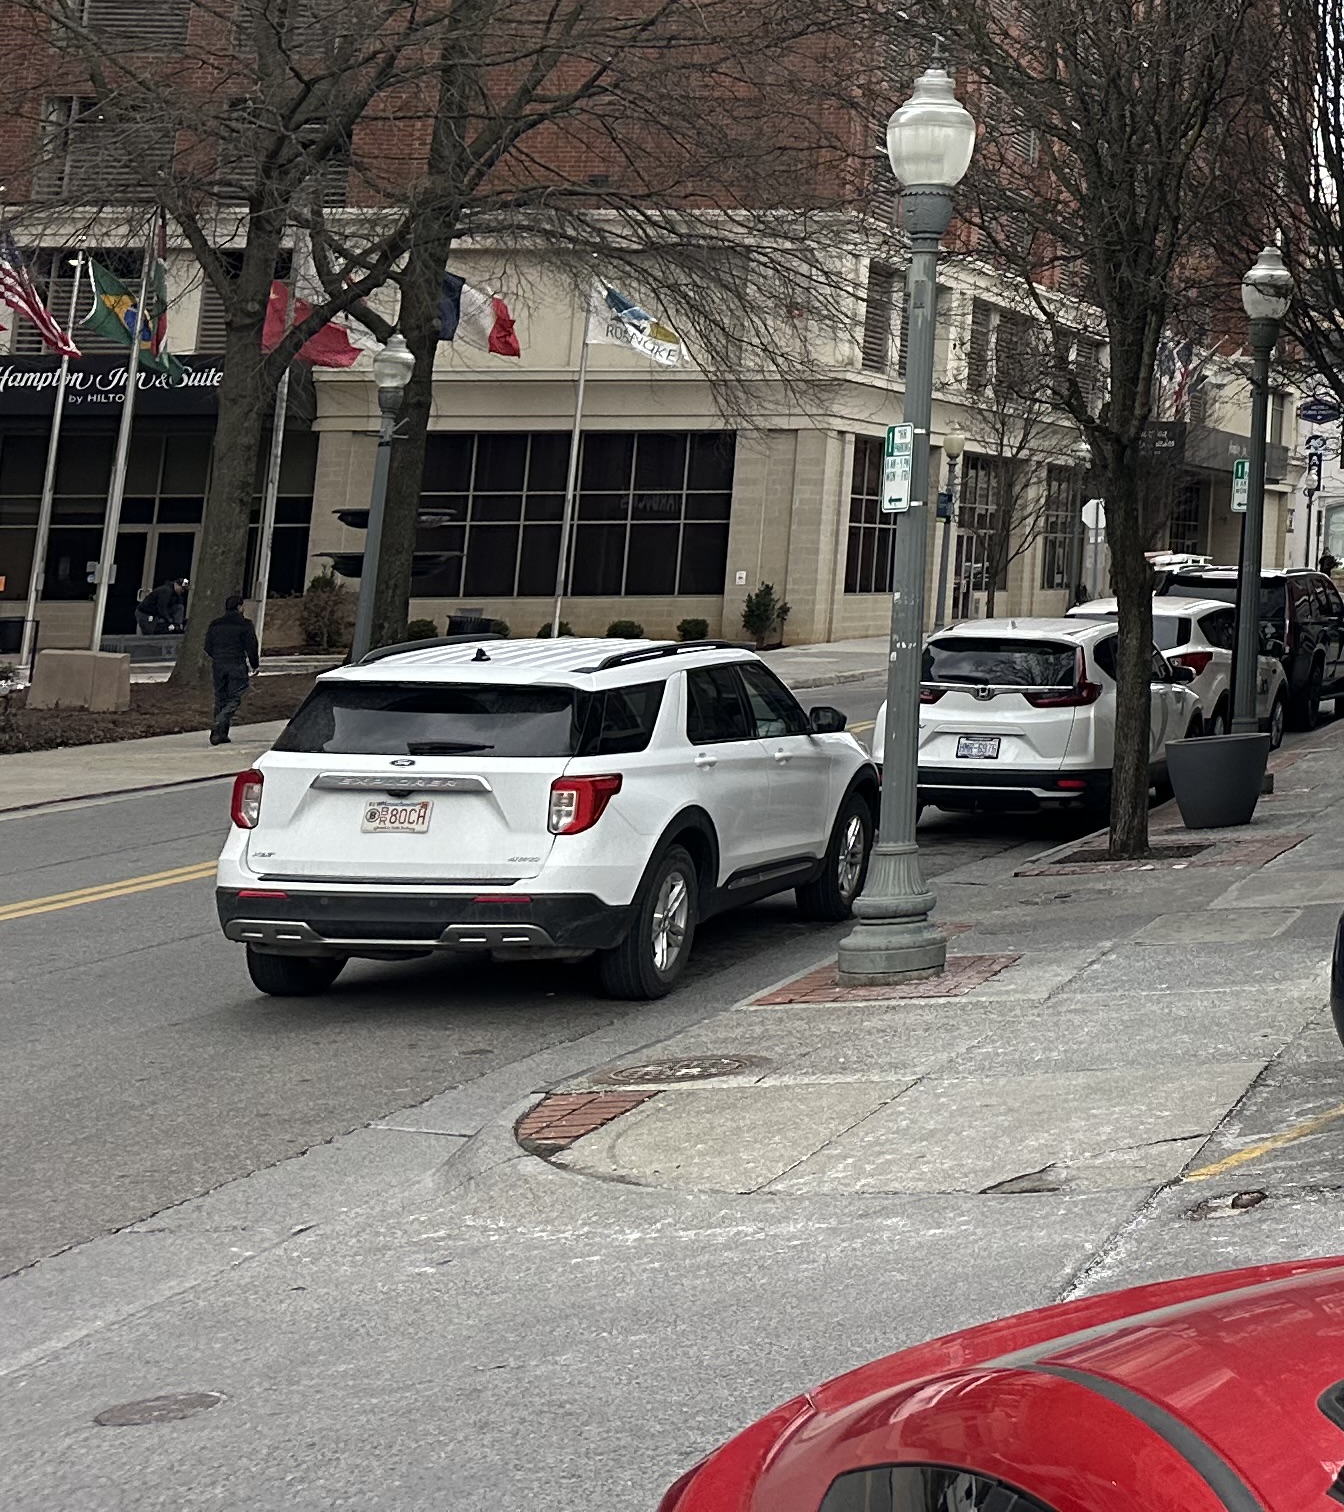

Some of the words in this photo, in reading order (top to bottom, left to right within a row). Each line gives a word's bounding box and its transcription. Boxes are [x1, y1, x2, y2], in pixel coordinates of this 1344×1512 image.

[605, 324, 678, 362] ROANOKE
[169, 365, 224, 388] Suite
[68, 394, 83, 404] by
[87, 393, 125, 403] HILTO
